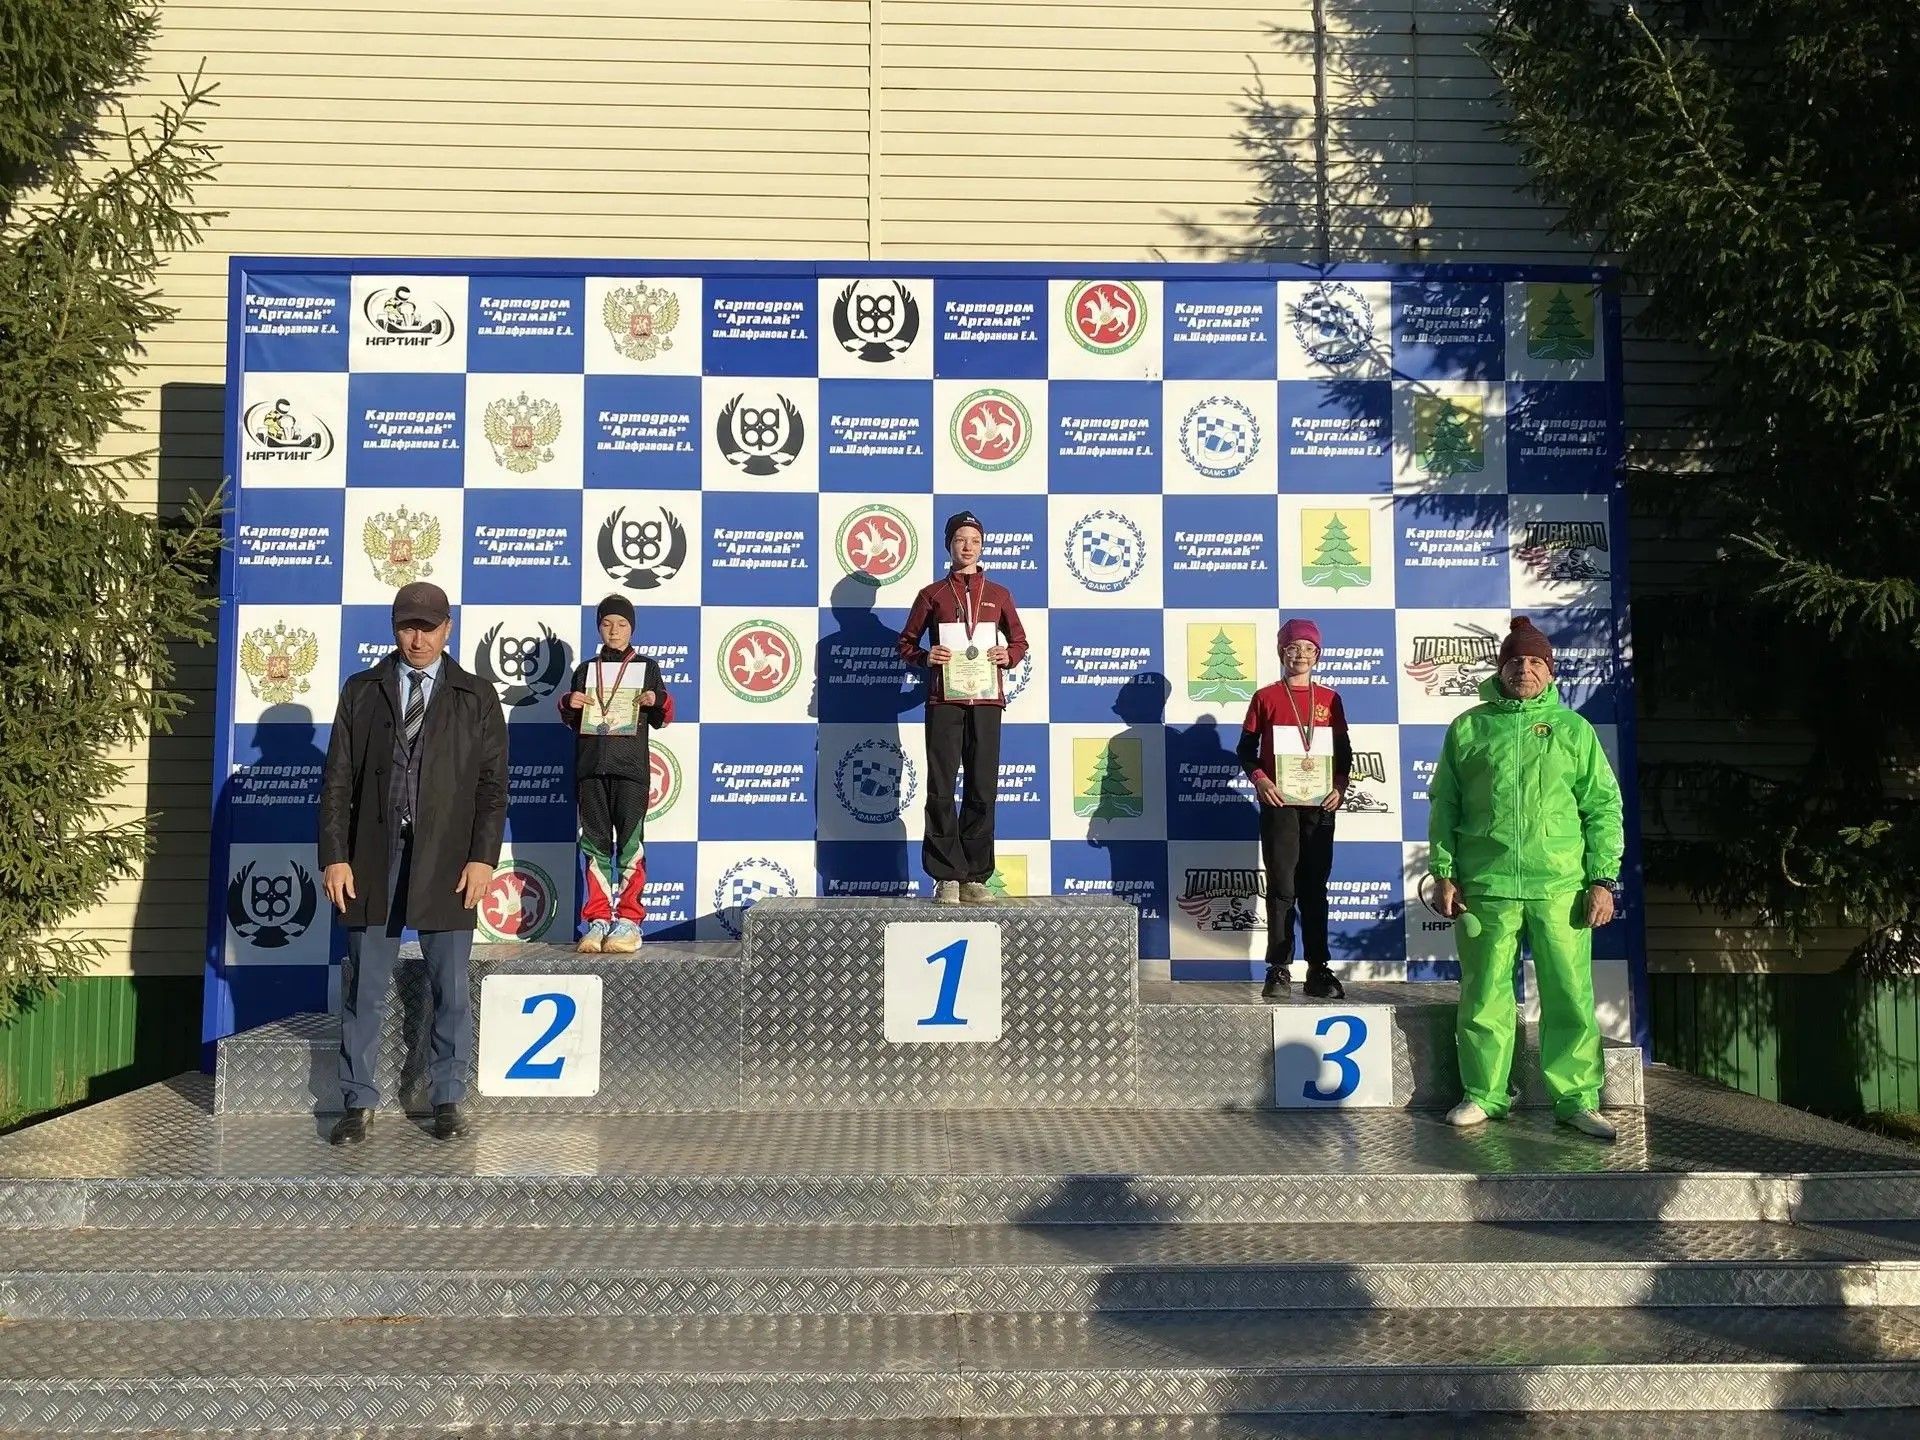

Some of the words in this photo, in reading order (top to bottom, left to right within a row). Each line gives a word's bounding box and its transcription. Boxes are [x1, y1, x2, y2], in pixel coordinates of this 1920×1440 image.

[246, 295, 335, 308] Картодром
[480, 297, 571, 310] Картодром
[715, 300, 804, 313] Картодром
[945, 302, 1034, 314] Картодром
[1176, 303, 1263, 315] Картодром
[1403, 305, 1490, 317] Картодром
[366, 337, 432, 346] КАРТИНГ
[365, 410, 456, 422] Картодром
[599, 412, 690, 425] Картодром
[831, 416, 920, 429] Картодром
[1061, 417, 1150, 429] Картодром
[1292, 417, 1381, 429] Картодром
[1522, 418, 1607, 430] Картодром
[246, 452, 312, 460] КАРТИНГ
[1202, 468, 1226, 476] ФАМС
[1228, 467, 1239, 476] РТ
[240, 526, 329, 538] Картодром
[475, 526, 568, 538] Картодром
[714, 529, 805, 542] Картодром
[1175, 532, 1264, 544] Картодром
[1406, 528, 1495, 540] Картодром
[1525, 522, 1608, 552] TORNADO
[1087, 582, 1111, 591] ФАМС
[1113, 582, 1124, 590] РТ
[1062, 646, 1151, 658] Картодром
[1414, 636, 1498, 666] TORNADO
[232, 764, 322, 777] Картодром
[713, 763, 804, 775] Картодром
[858, 814, 882, 822] ФАМС
[829, 879, 920, 892] Картодром
[1064, 878, 1155, 891] Картодром
[1186, 868, 1266, 899] TORNADO
[1204, 888, 1252, 898] КАРТИНГ
[916, 939, 968, 1026] 1
[505, 993, 577, 1080] 2
[1302, 1015, 1368, 1103] 3
